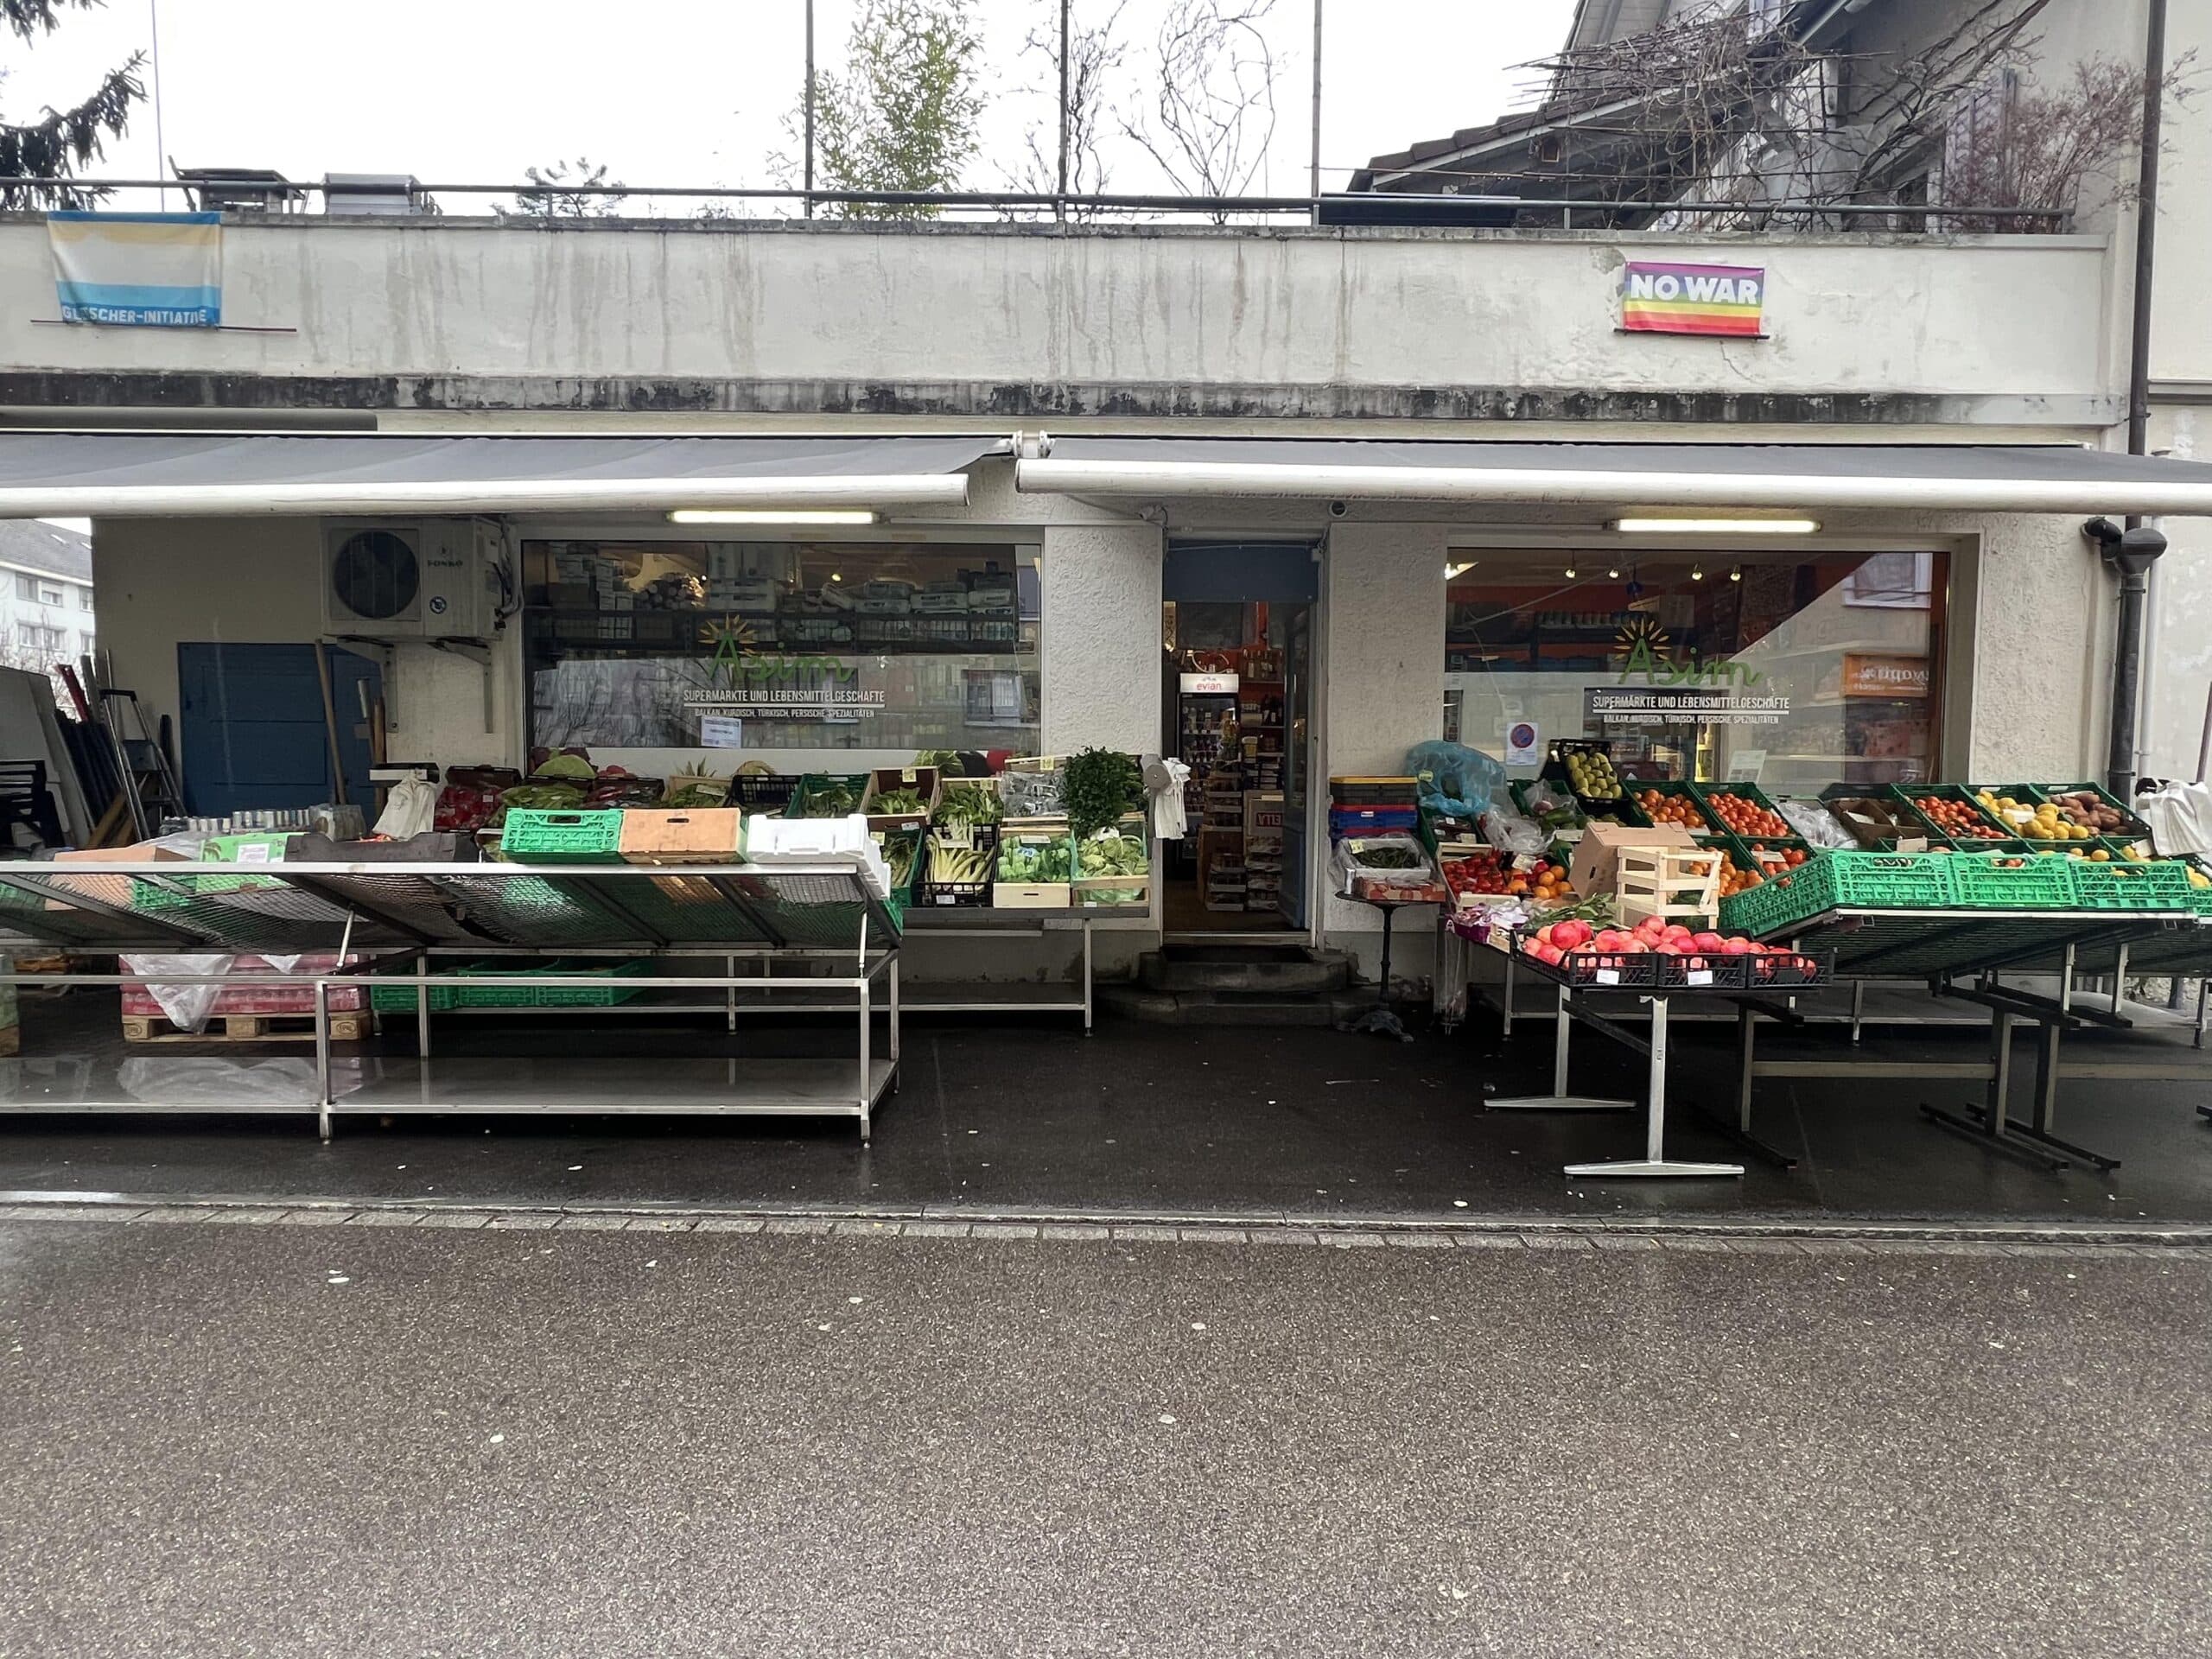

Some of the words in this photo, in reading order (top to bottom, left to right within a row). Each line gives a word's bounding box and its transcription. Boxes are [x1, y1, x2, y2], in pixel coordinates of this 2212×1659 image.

[1630, 274, 1680, 301] NO
[1684, 276, 1758, 305] WAR
[709, 631, 855, 683] Asim
[1618, 638, 1764, 686] Asim
[750, 690, 768, 702] UND
[1197, 682, 1222, 690] evian
[1658, 696, 1675, 709] UND
